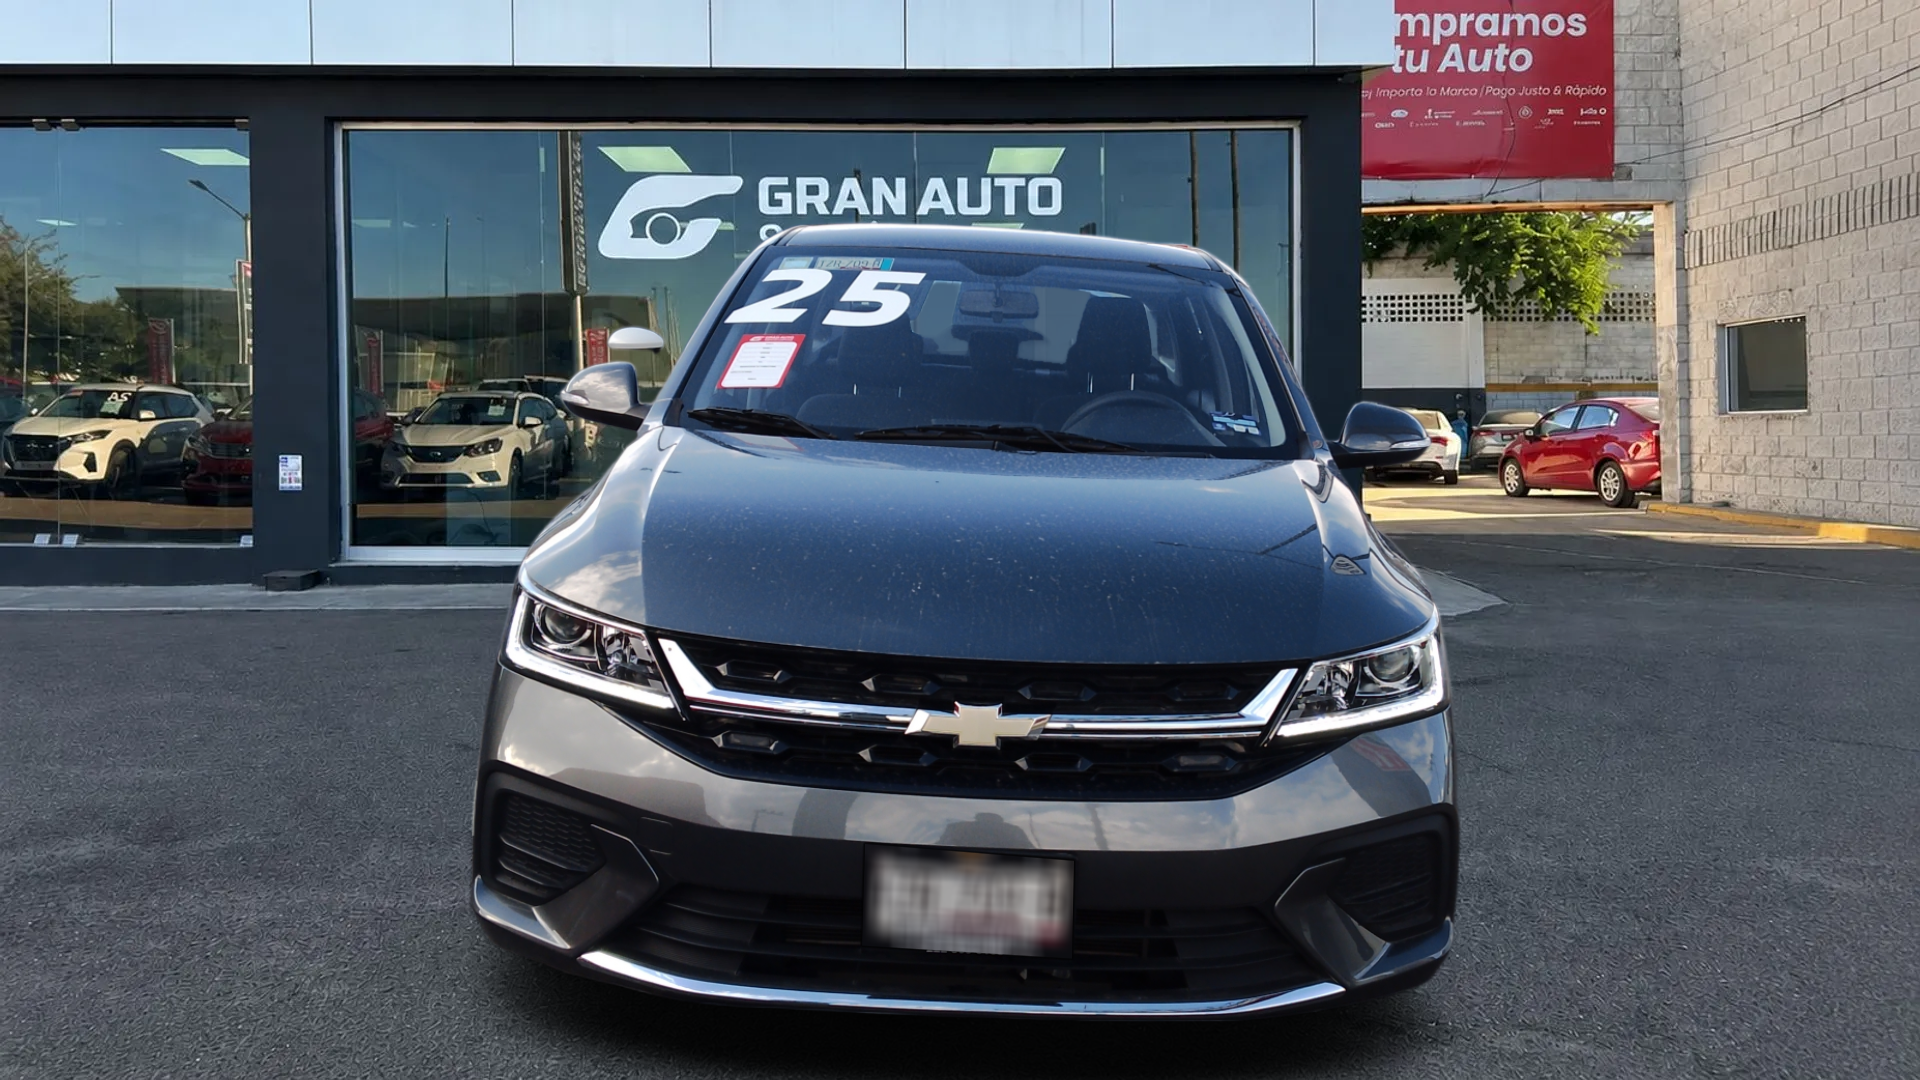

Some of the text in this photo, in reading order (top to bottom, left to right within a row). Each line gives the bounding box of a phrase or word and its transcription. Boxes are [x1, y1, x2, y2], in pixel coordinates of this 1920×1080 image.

[1392, 43, 1534, 73] tu Auto
[1376, 87, 1423, 99] Importa
[1426, 86, 1437, 96] la
[1440, 86, 1478, 97] Marca
[1519, 85, 1551, 96] Justo
[1553, 85, 1562, 96] &
[758, 177, 1062, 216] GRAN AUTO
[724, 268, 927, 327] 25
